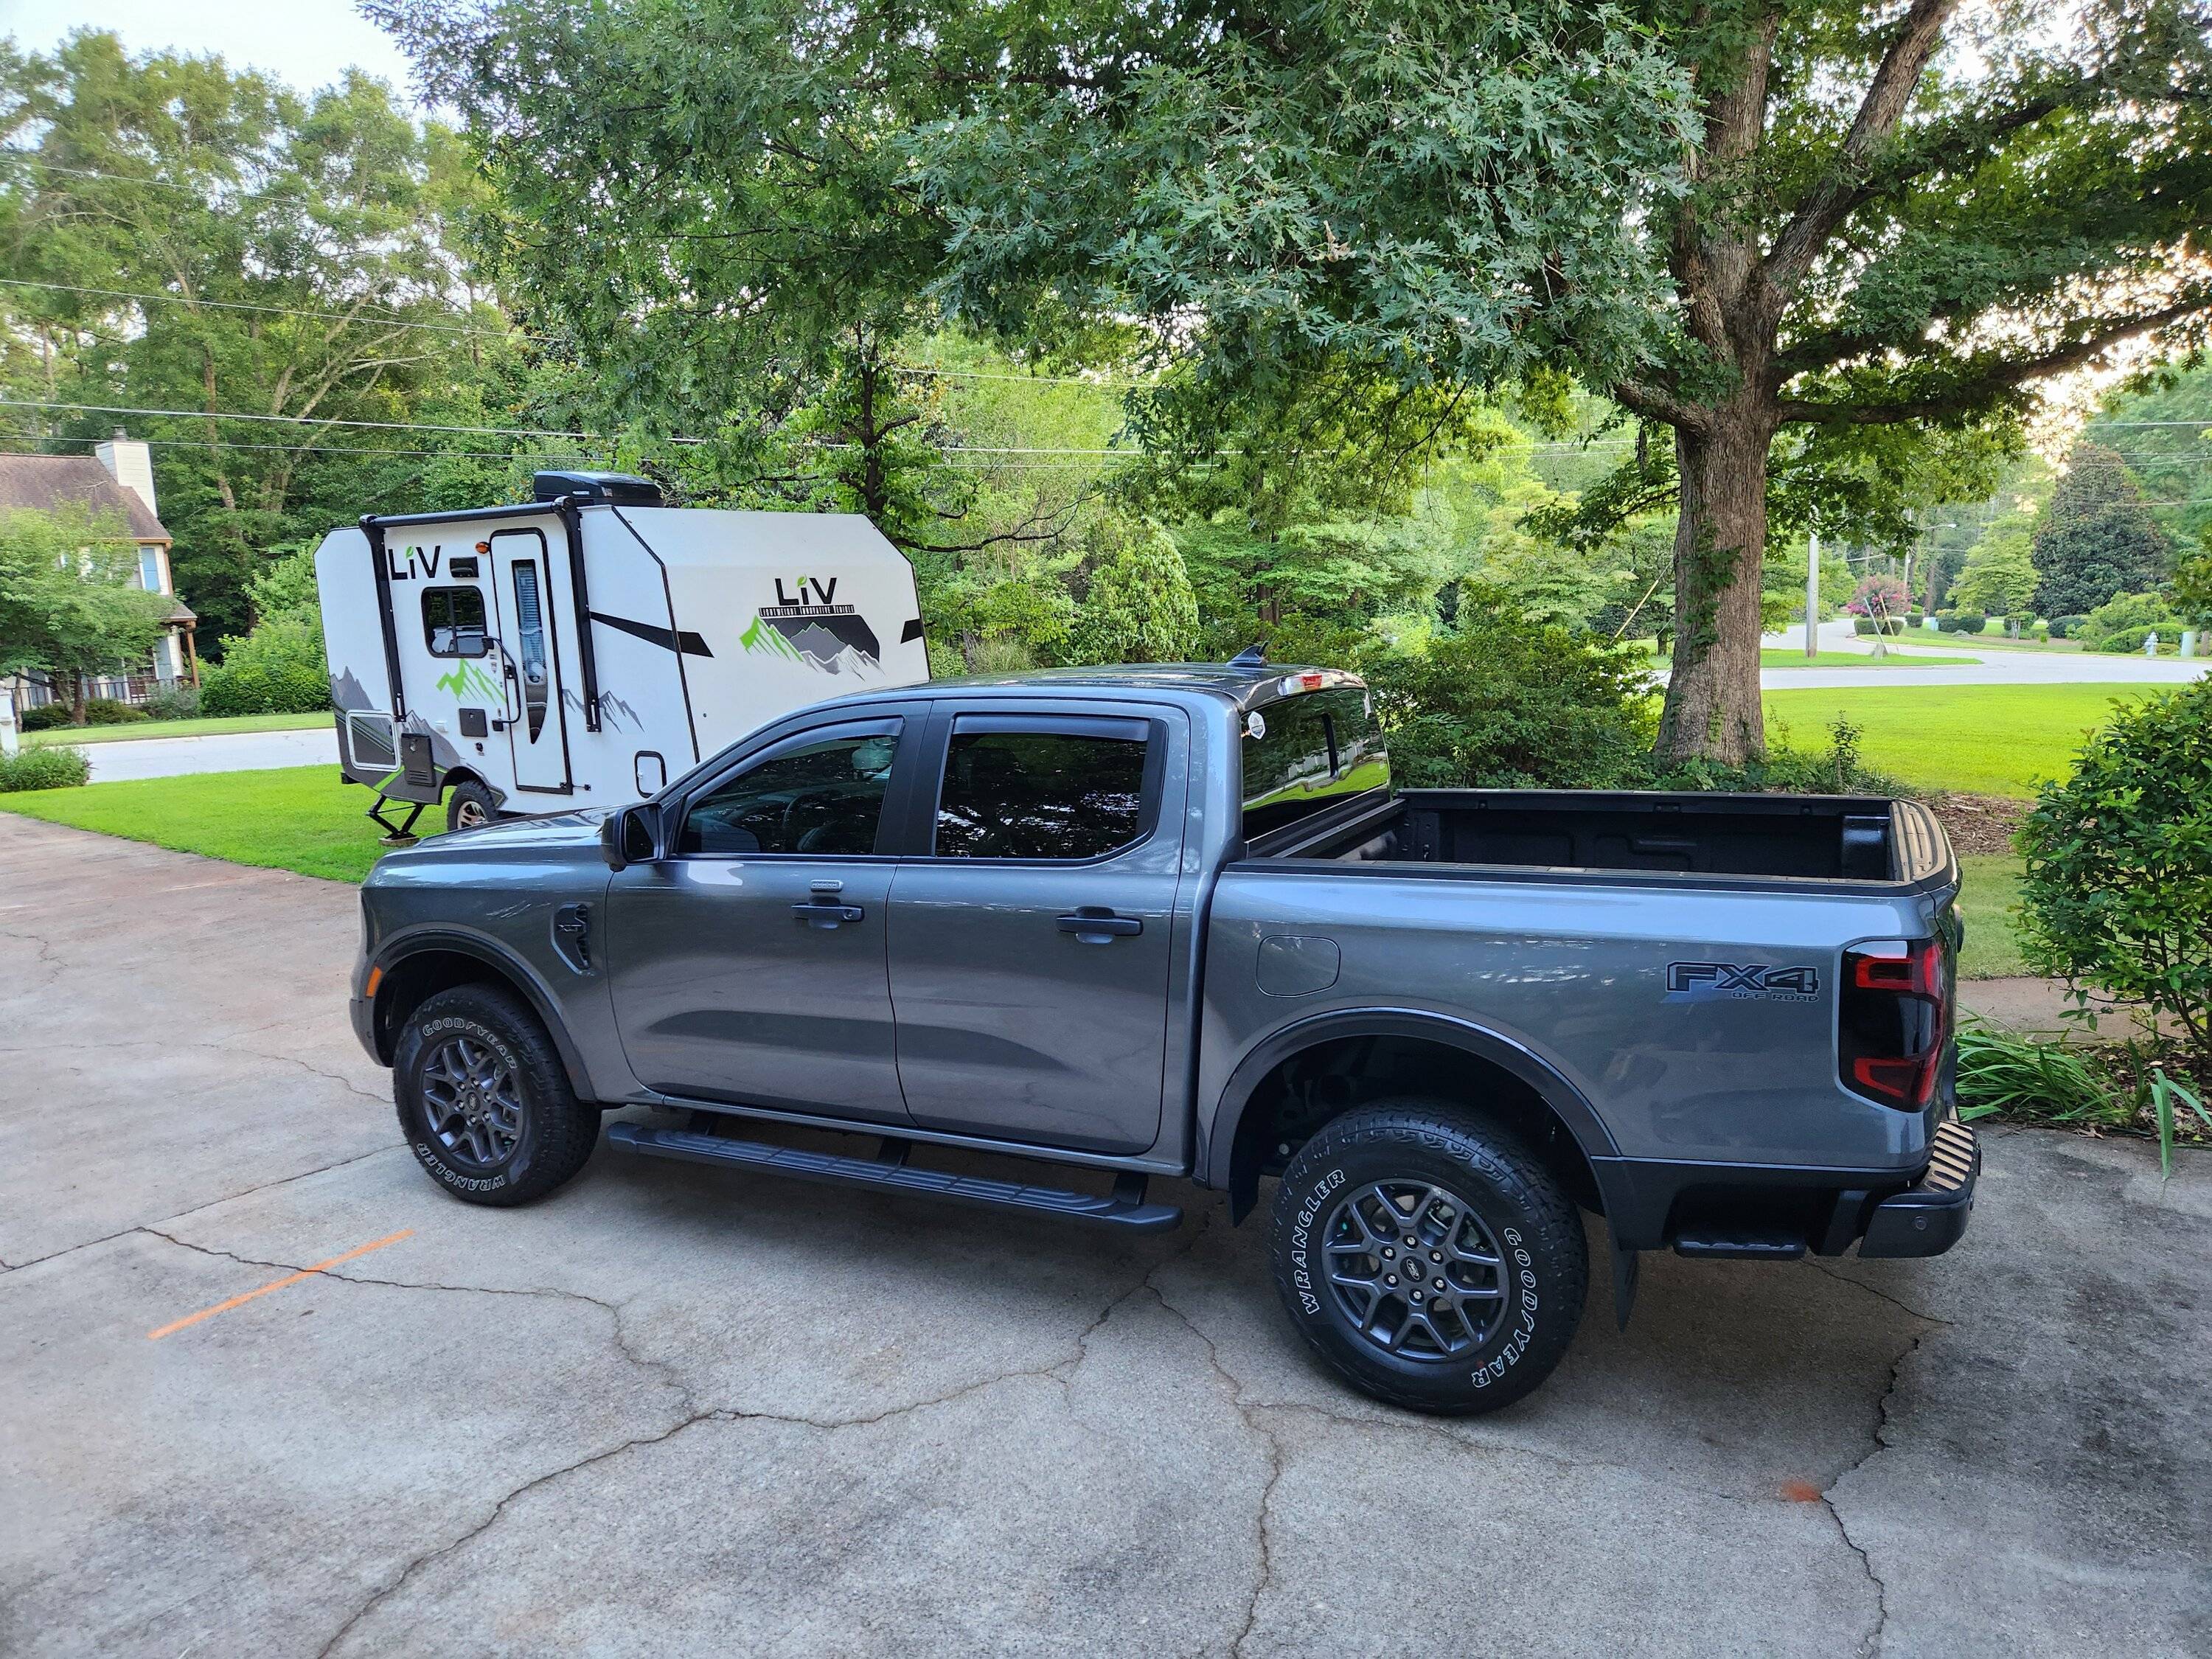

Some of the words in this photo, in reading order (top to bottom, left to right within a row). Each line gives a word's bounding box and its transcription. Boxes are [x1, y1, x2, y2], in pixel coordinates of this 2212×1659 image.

[1666, 961, 1820, 995] FX4
[1732, 991, 1767, 1000] OFF
[1772, 992, 1820, 1002] ROAD
[422, 1018, 518, 1070] GOODYEAR
[416, 1143, 507, 1192] WRANGLER
[1292, 1169, 1346, 1315] WRANGLER
[1472, 1227, 1538, 1388] GOODYEAR
